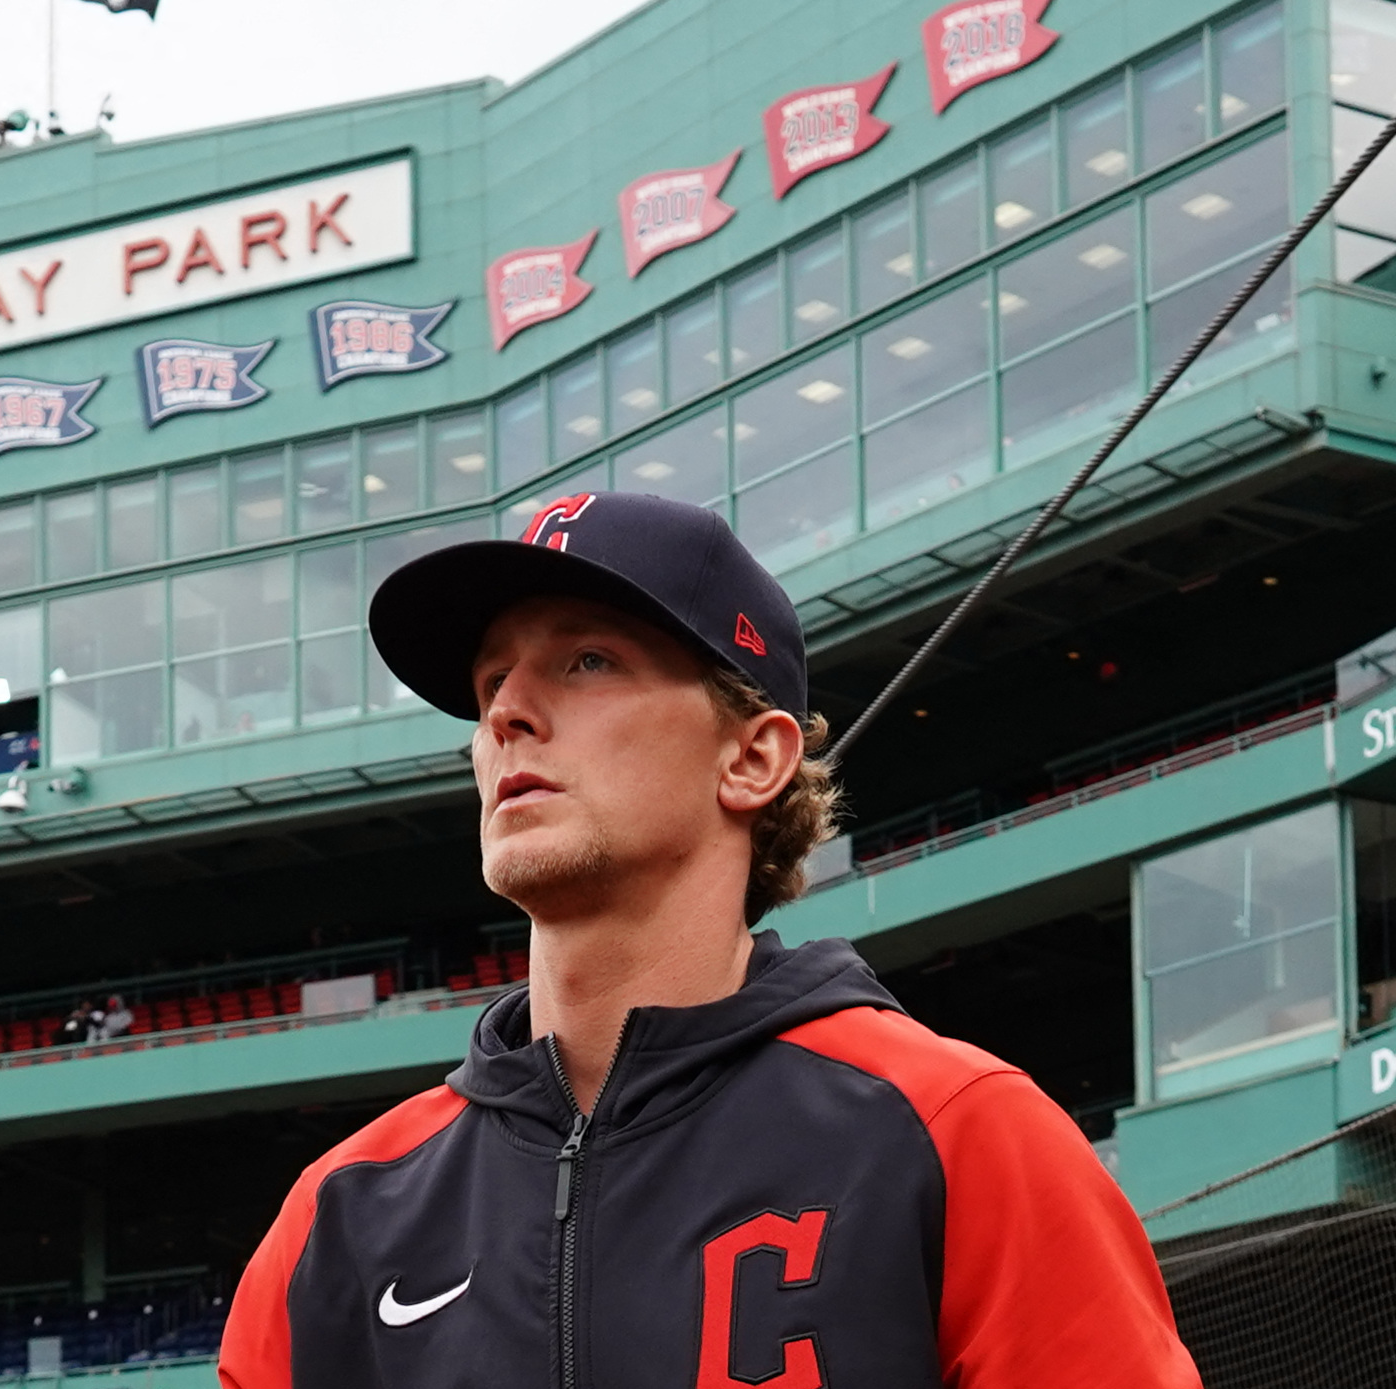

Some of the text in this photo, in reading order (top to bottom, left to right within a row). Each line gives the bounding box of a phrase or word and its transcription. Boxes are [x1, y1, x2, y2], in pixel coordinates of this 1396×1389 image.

[780, 102, 858, 156] 2013
[632, 186, 705, 237] 2007
[121, 194, 353, 296] PARK
[330, 319, 414, 355] 1986
[156, 359, 237, 392] 1975
